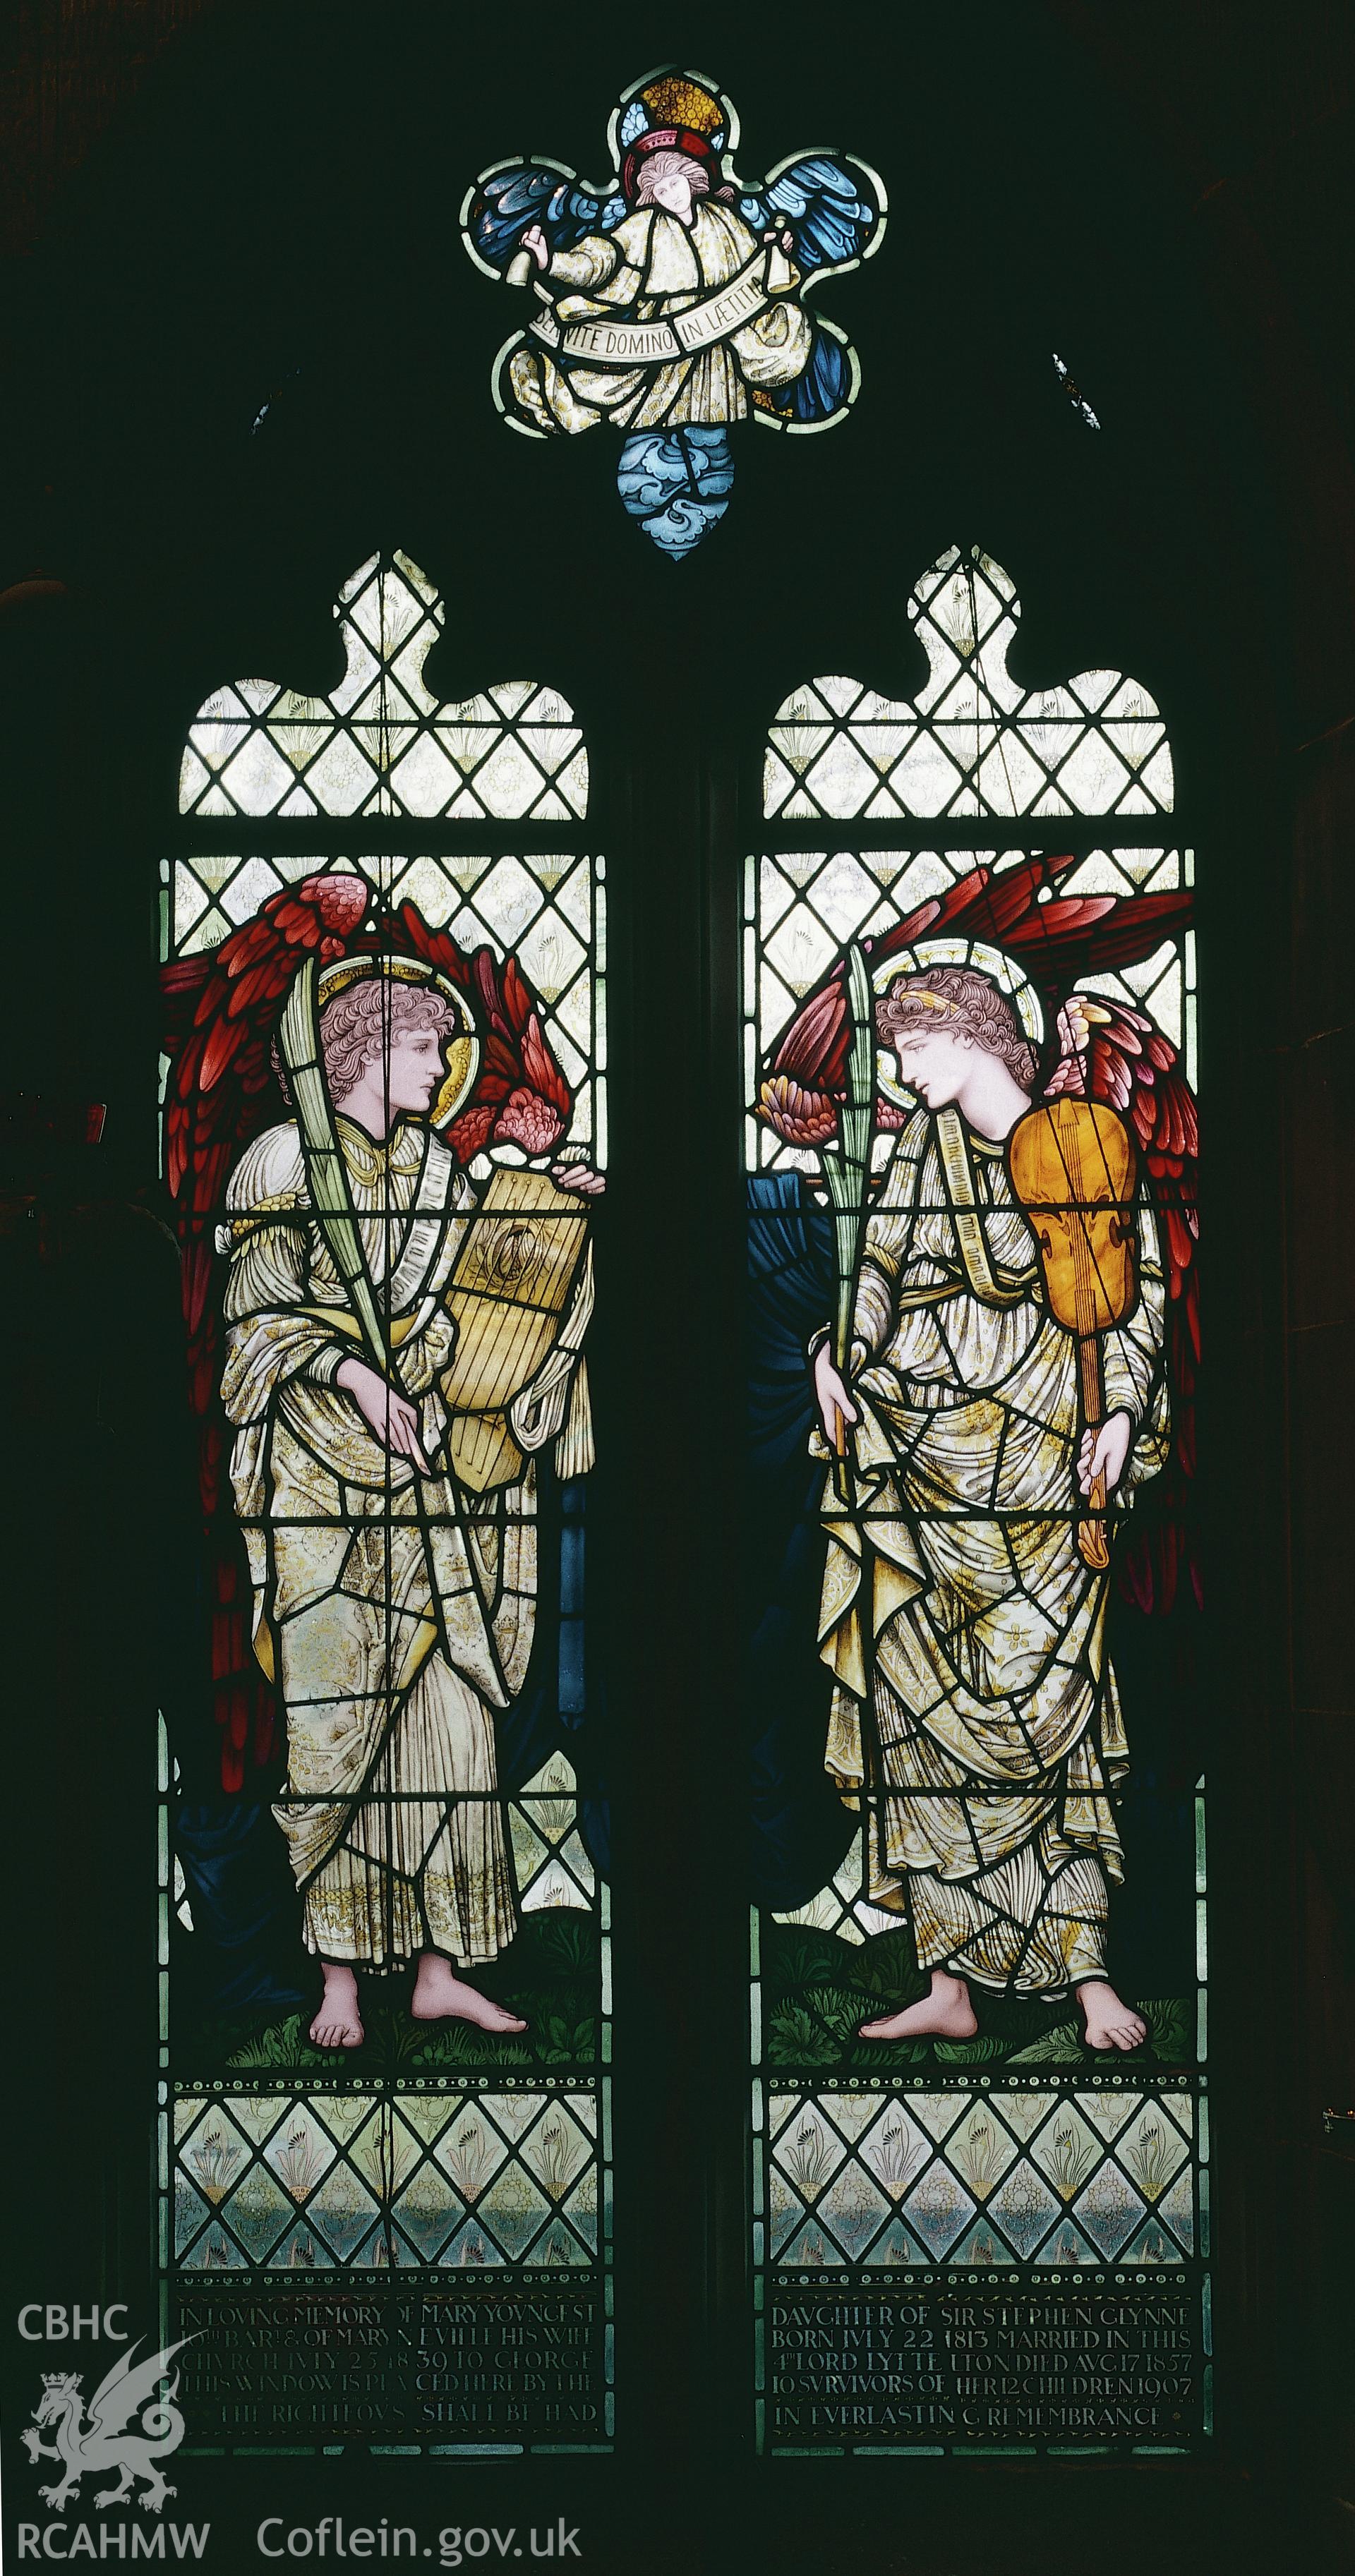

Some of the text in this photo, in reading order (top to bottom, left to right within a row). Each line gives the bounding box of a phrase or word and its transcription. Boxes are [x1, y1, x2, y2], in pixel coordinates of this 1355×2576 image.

[606, 332, 673, 354] DOMINO
[682, 319, 704, 342] IN
[179, 2306, 202, 2326] IN
[294, 2306, 387, 2326] MEMORY
[421, 2304, 481, 2323] MARY
[771, 2306, 894, 2326] DAVGHTER
[900, 2306, 931, 2326] OF
[941, 2306, 977, 2326] SIR
[982, 2306, 1093, 2326] STEPHEN
[303, 2328, 333, 2347] OF
[500, 2327, 538, 2346] HIS
[771, 2329, 834, 2349] BORN
[903, 2329, 934, 2349] 22
[944, 2330, 989, 2349] 1813
[996, 2329, 1101, 2350] MARRIED
[1106, 2330, 1130, 2349] IN
[1136, 2330, 1192, 2349] THIS
[349, 2352, 378, 2370] 25
[454, 2350, 483, 2369] TO
[796, 2352, 858, 2371] LORD
[1016, 2353, 1069, 2372] DIED
[1121, 2353, 1140, 2371] 17
[1145, 2353, 1193, 2372] 1857
[342, 2374, 360, 2392] IS
[524, 2374, 548, 2392] BY
[798, 2374, 914, 2394] SVRVIVORS
[918, 2374, 945, 2394] OF
[956, 2377, 996, 2395] HER
[1001, 2376, 1020, 2395] 12
[1022, 2376, 1133, 2396] CHILDREN
[1137, 2376, 1193, 2398] 1907
[544, 2403, 598, 2422] HAD
[775, 2405, 802, 2425] IN
[988, 2407, 1163, 2426] REMEMBRANCE
